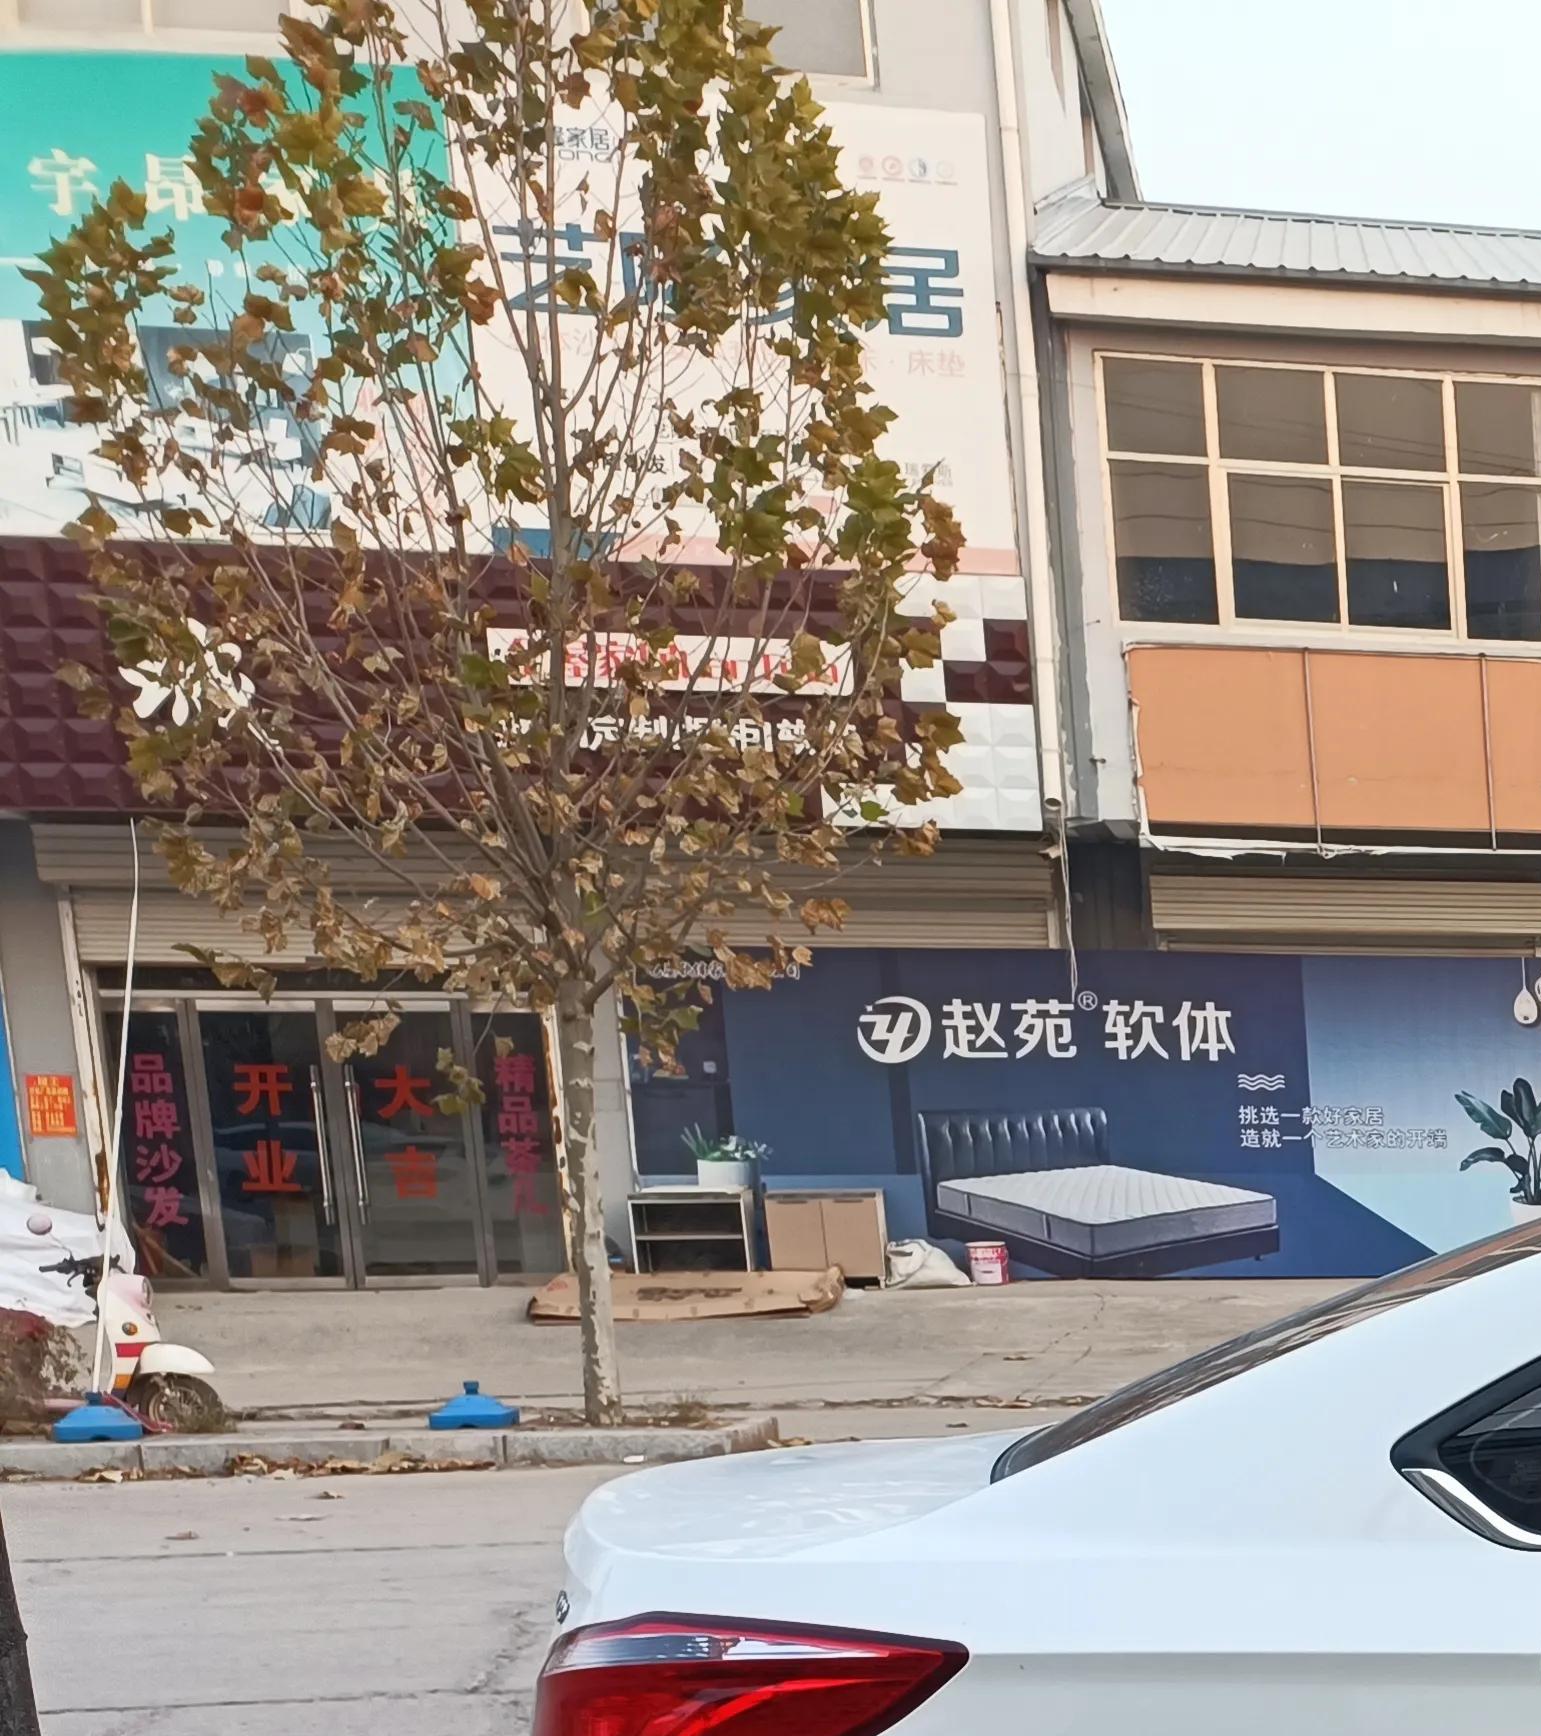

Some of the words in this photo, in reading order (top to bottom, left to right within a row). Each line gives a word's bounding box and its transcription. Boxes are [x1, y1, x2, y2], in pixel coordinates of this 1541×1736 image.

[1238, 1105, 1385, 1126] 挑选一款好家居
[130, 1053, 189, 1228] 品牌沙发
[1239, 1127, 1448, 1149] 造就一个艺术家的开端
